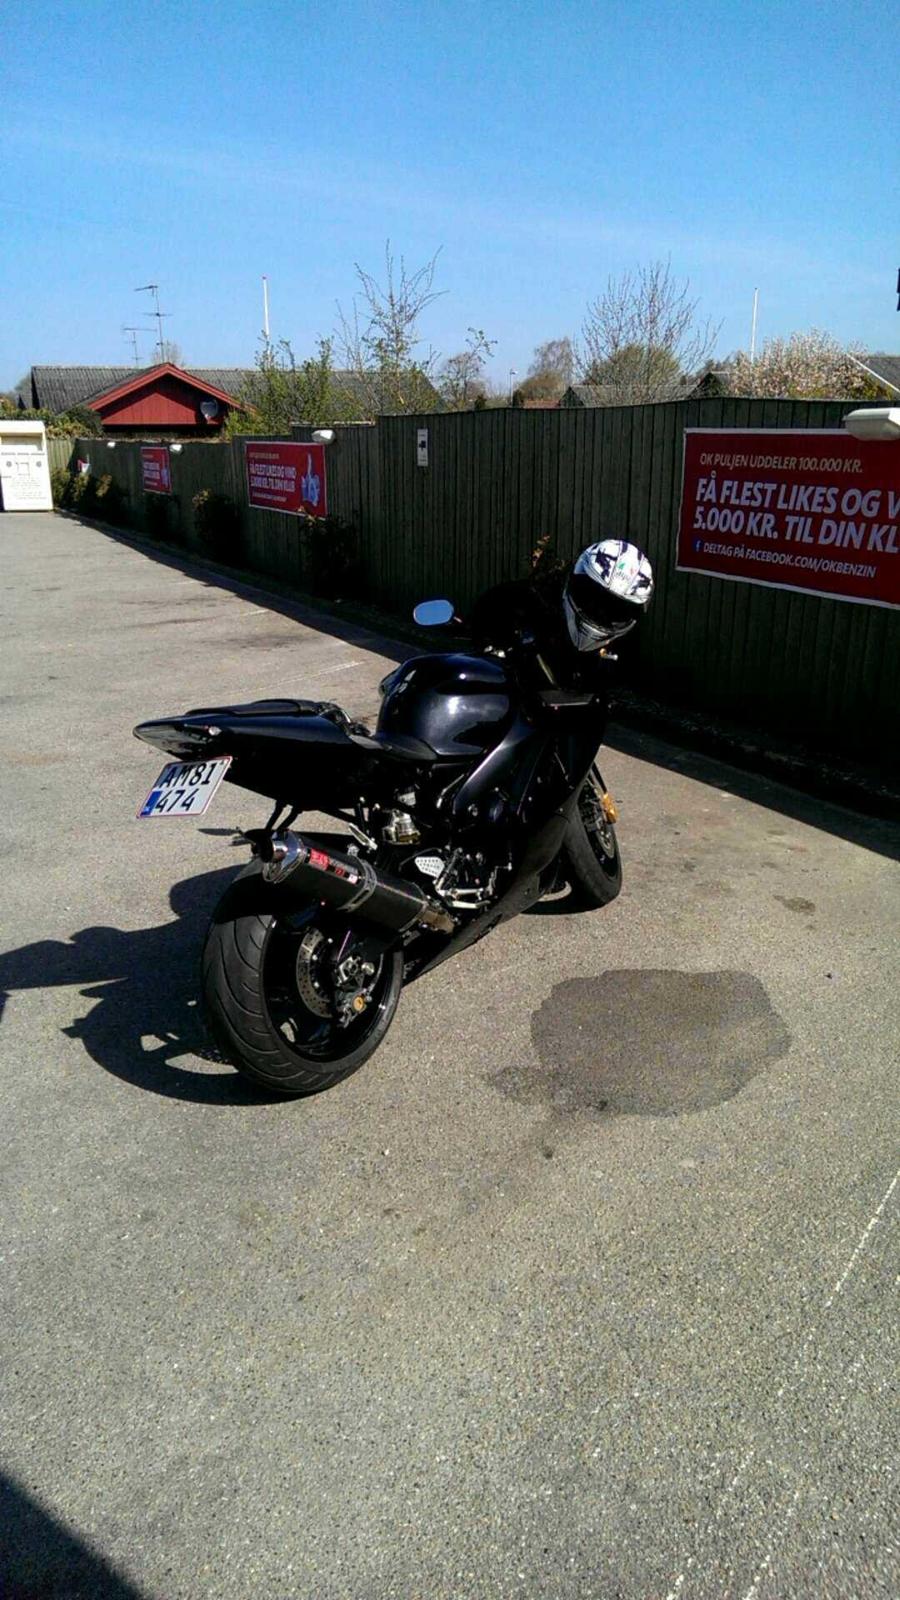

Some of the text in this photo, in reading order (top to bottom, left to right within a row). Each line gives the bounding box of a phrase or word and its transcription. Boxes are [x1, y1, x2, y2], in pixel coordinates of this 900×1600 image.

[700, 453, 863, 473] OK PULJEN UDDELER 100.000 KR.
[695, 470, 717, 503] FÅ
[719, 480, 777, 508] FLEST
[777, 484, 839, 514] LIKES
[841, 488, 882, 517] OG
[693, 506, 745, 532] 5.000
[745, 511, 778, 539] KR.
[784, 515, 814, 543] TIL
[818, 518, 866, 549] DIN
[703, 542, 734, 557] DELTAG
[733, 543, 745, 559] PÅ
[745, 549, 876, 578] FACEBOOK.COM/OKBENZIN
[159, 762, 217, 788] AM81
[155, 788, 200, 813] 474
